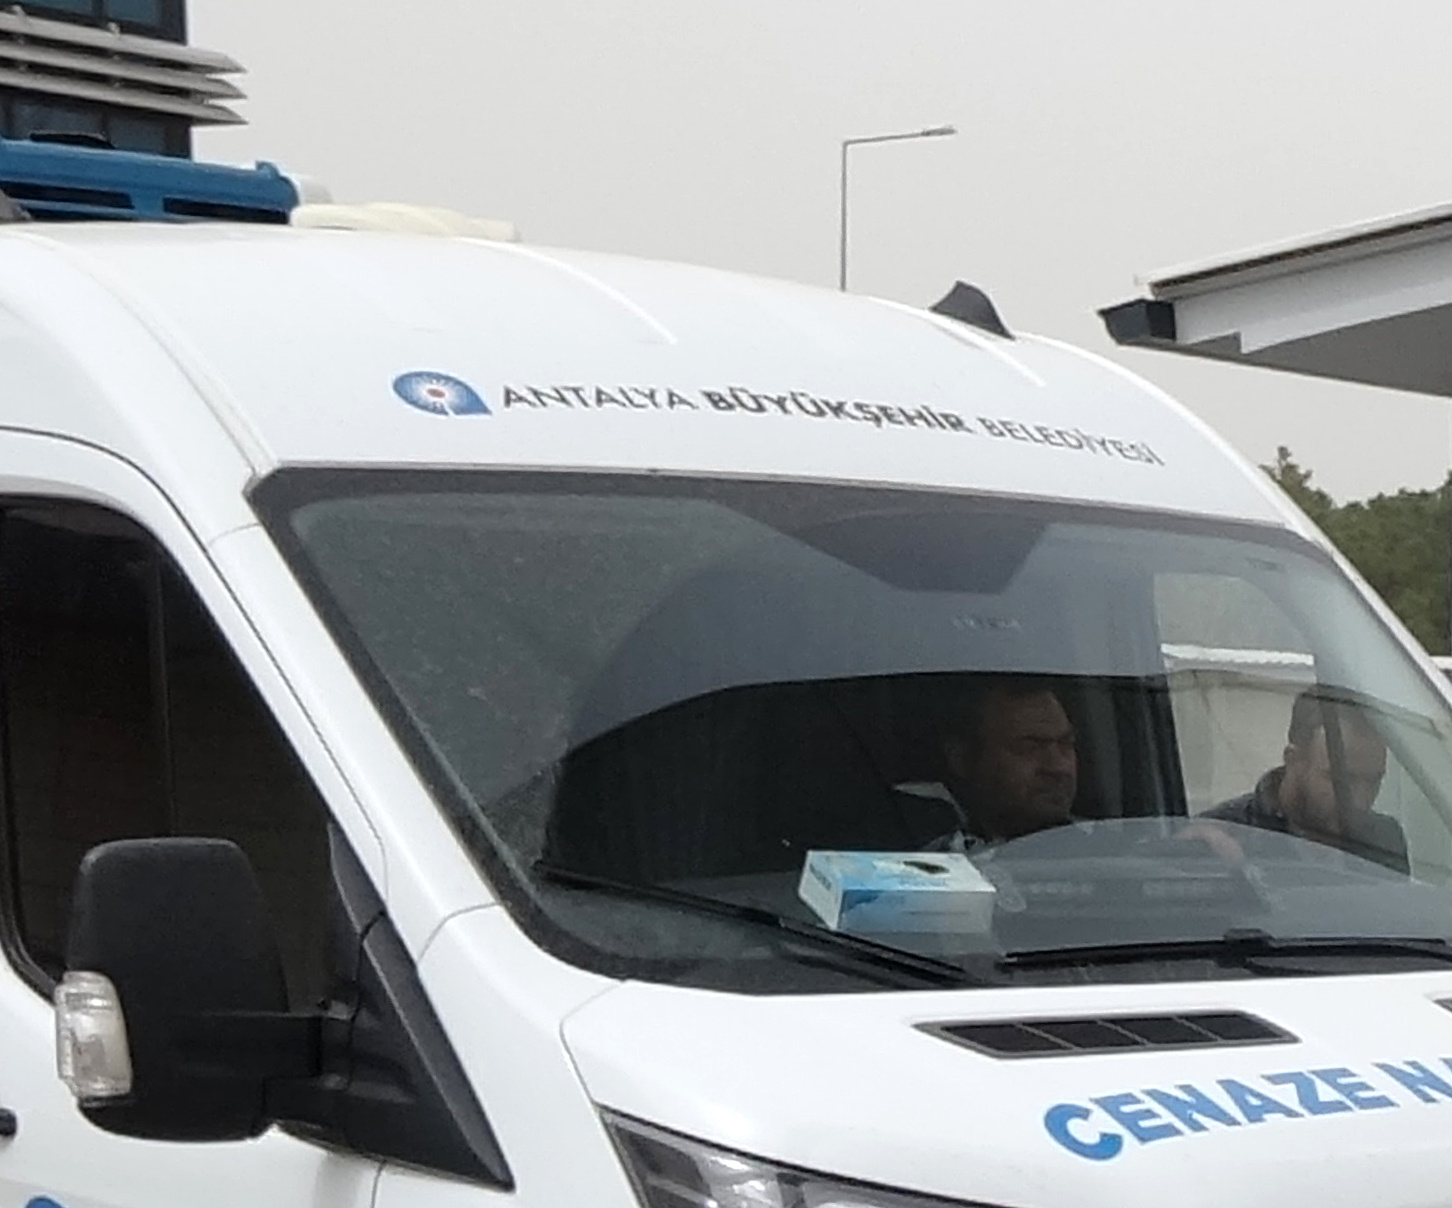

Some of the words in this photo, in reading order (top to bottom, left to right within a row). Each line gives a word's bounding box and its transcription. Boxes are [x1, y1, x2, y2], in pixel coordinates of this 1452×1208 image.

[503, 386, 699, 409] ANTALYA
[701, 385, 977, 431] BÜYÜKŞEHİR
[976, 417, 1166, 466] BELEDİYESİ
[1043, 1066, 1400, 1161] CENAZE
